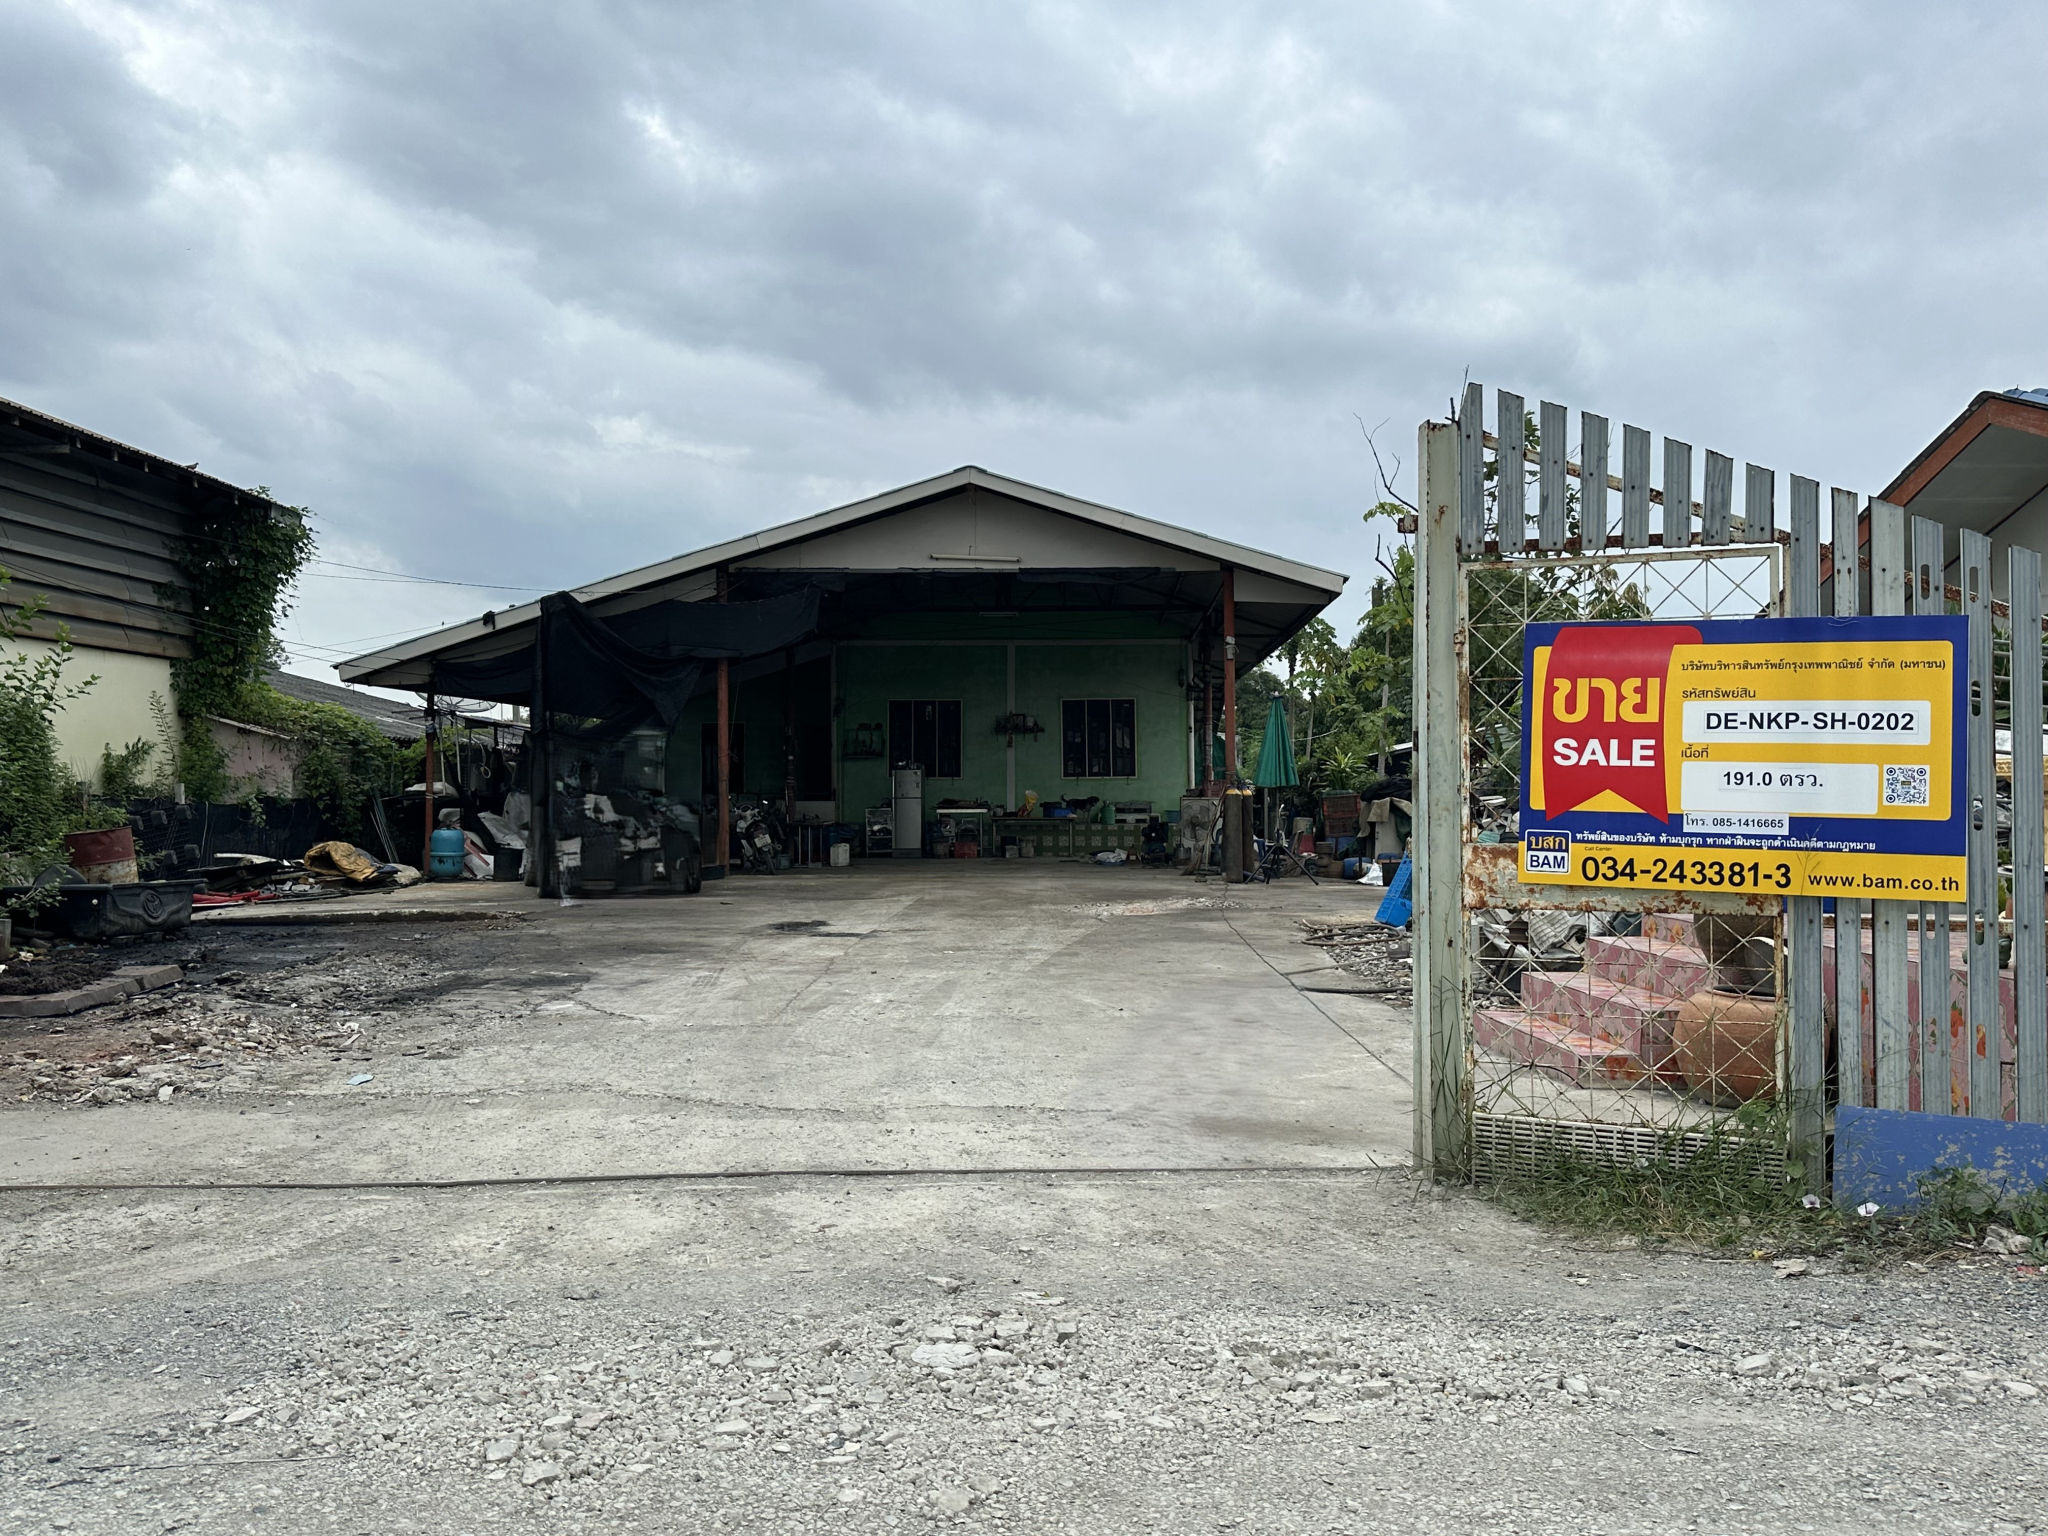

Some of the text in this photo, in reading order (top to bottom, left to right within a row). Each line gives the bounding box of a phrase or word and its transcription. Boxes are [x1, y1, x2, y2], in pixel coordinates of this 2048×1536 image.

[1868, 658, 1895, 670] จำกัด
[1900, 659, 1946, 670] (มหาชน)
[1553, 677, 1660, 723] ขาย
[1682, 687, 1756, 699] รหัสทรัพย์สิน
[1706, 712, 1914, 731] DE-NKP-SH-0202
[1553, 738, 1656, 767] SALE
[1681, 745, 1709, 758] เนื้อที่
[1723, 771, 1824, 788] 191.0 ตรว.
[1685, 813, 1784, 829] โทร. 085-1416665
[1529, 835, 1566, 850] บสก
[1576, 830, 1656, 843] ทรัพย์สินของบริษัท
[1529, 854, 1566, 869] BAM
[1581, 856, 1792, 889] 034-243381-3
[1808, 873, 1959, 892] www.bam.co.th
